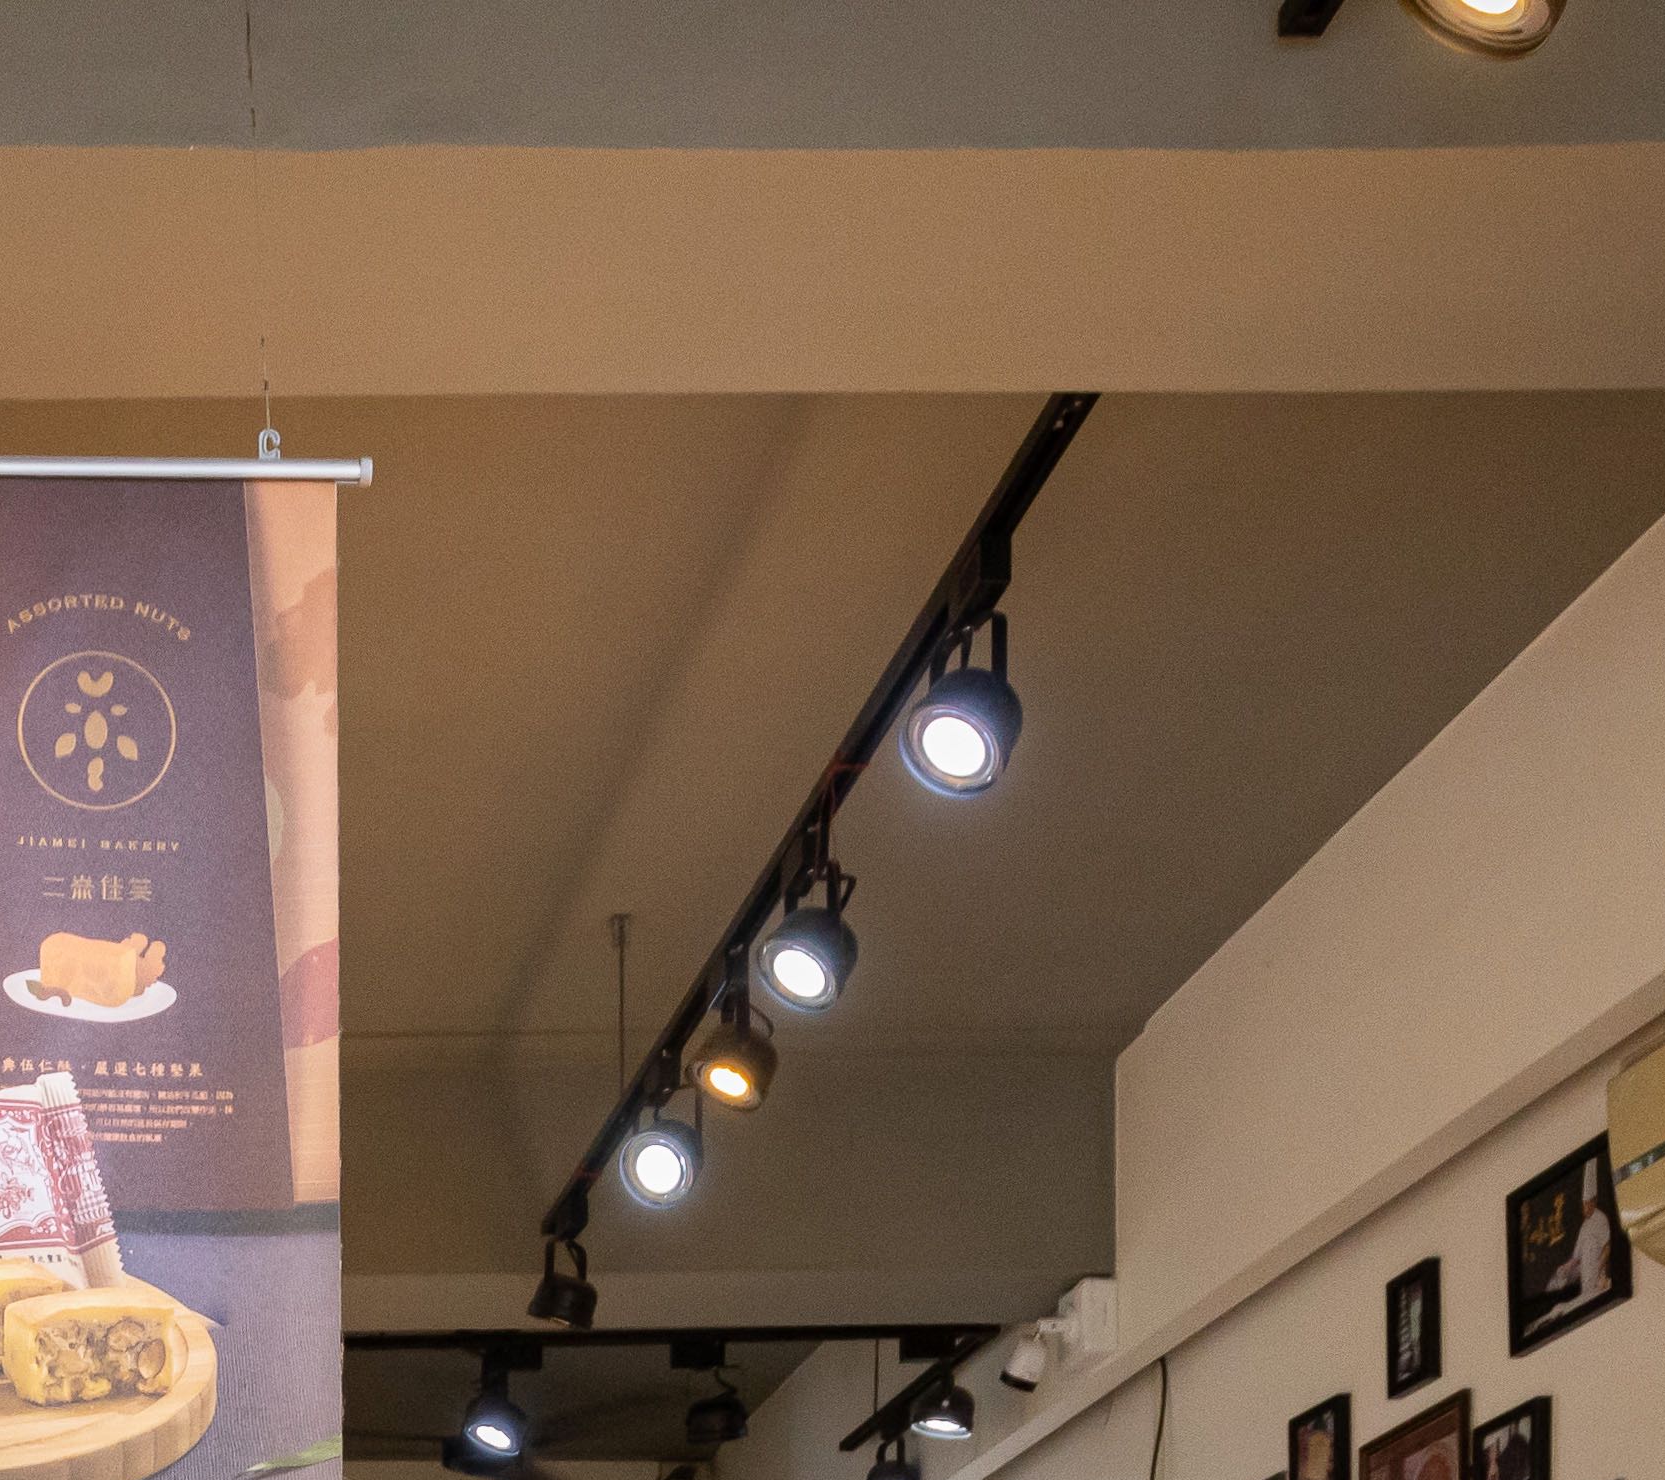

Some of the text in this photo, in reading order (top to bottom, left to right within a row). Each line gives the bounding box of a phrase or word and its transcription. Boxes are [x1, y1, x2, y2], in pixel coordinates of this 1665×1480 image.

[5, 594, 193, 643] ASSORTED NUTS
[17, 835, 180, 852] JIAMEI BAKERY
